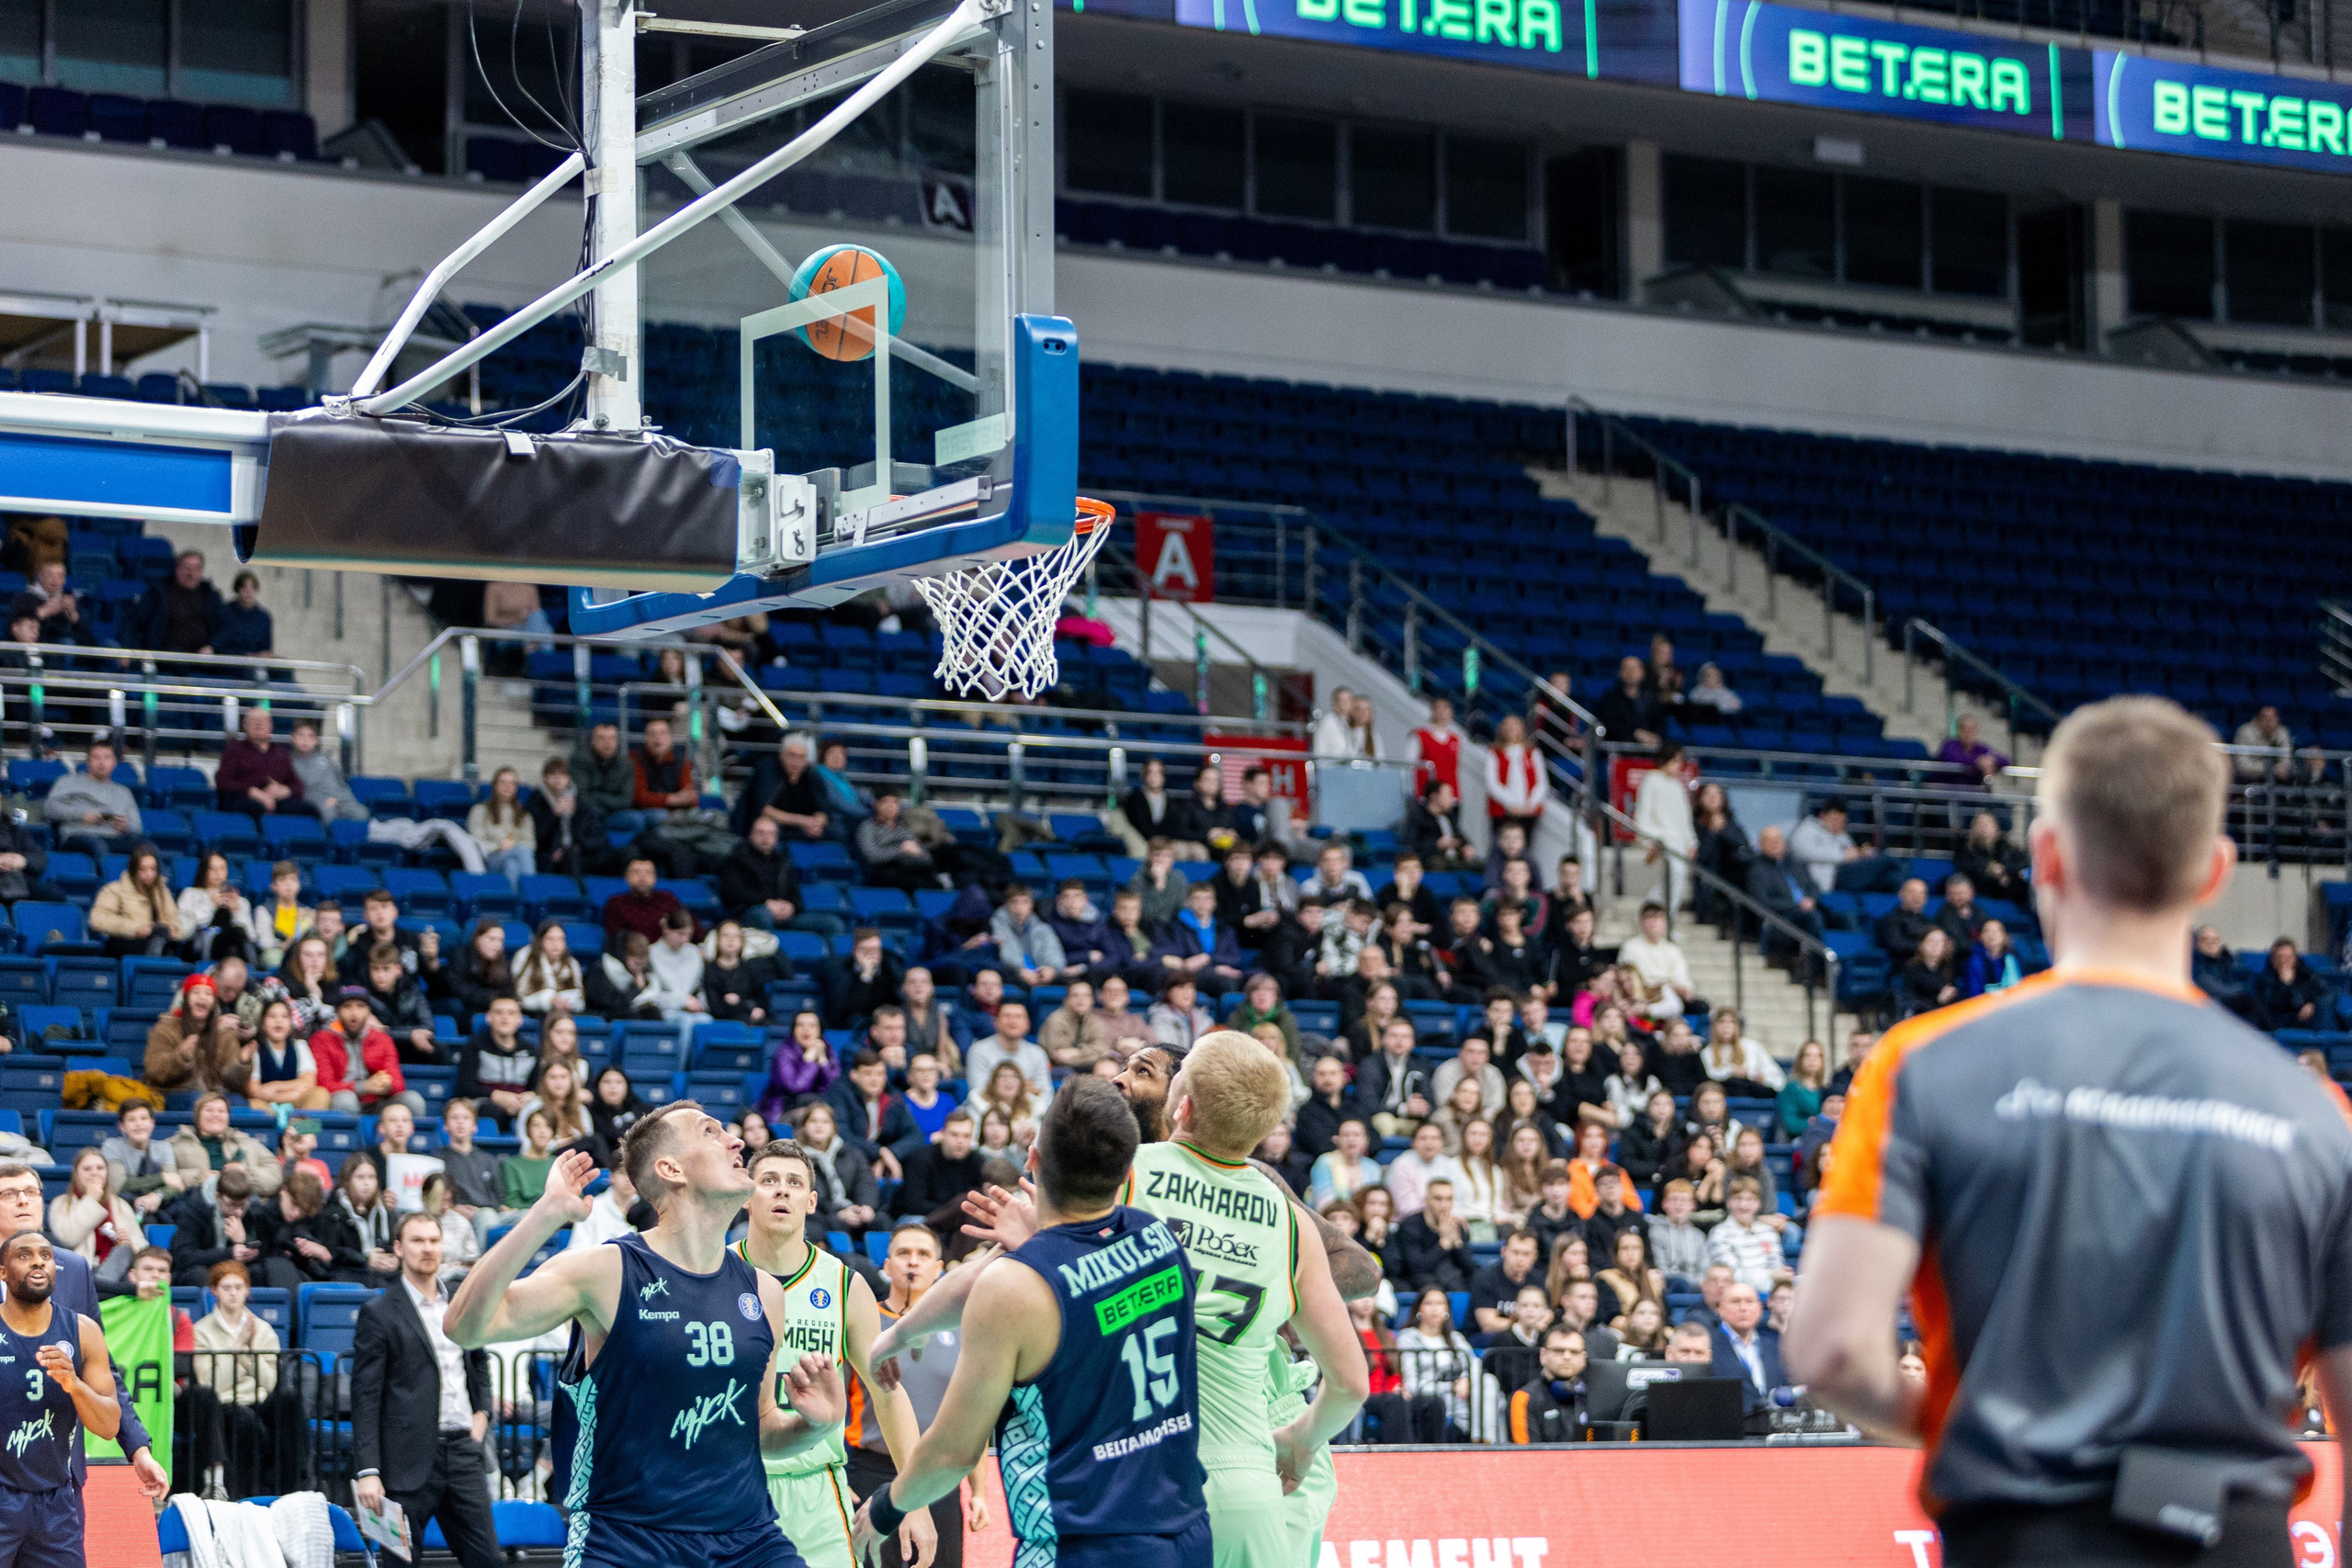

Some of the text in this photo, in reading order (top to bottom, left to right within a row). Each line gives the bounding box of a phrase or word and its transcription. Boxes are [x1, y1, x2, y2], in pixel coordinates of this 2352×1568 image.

[2154, 78, 2352, 156] BETER
[1145, 1170, 1278, 1228] ZAKHAROV
[639, 1309, 680, 1322] Kempa
[797, 1318, 835, 1328] REGION
[684, 1321, 735, 1367] 38
[26, 1369, 44, 1402] 3
[1121, 1315, 1181, 1422] 15
